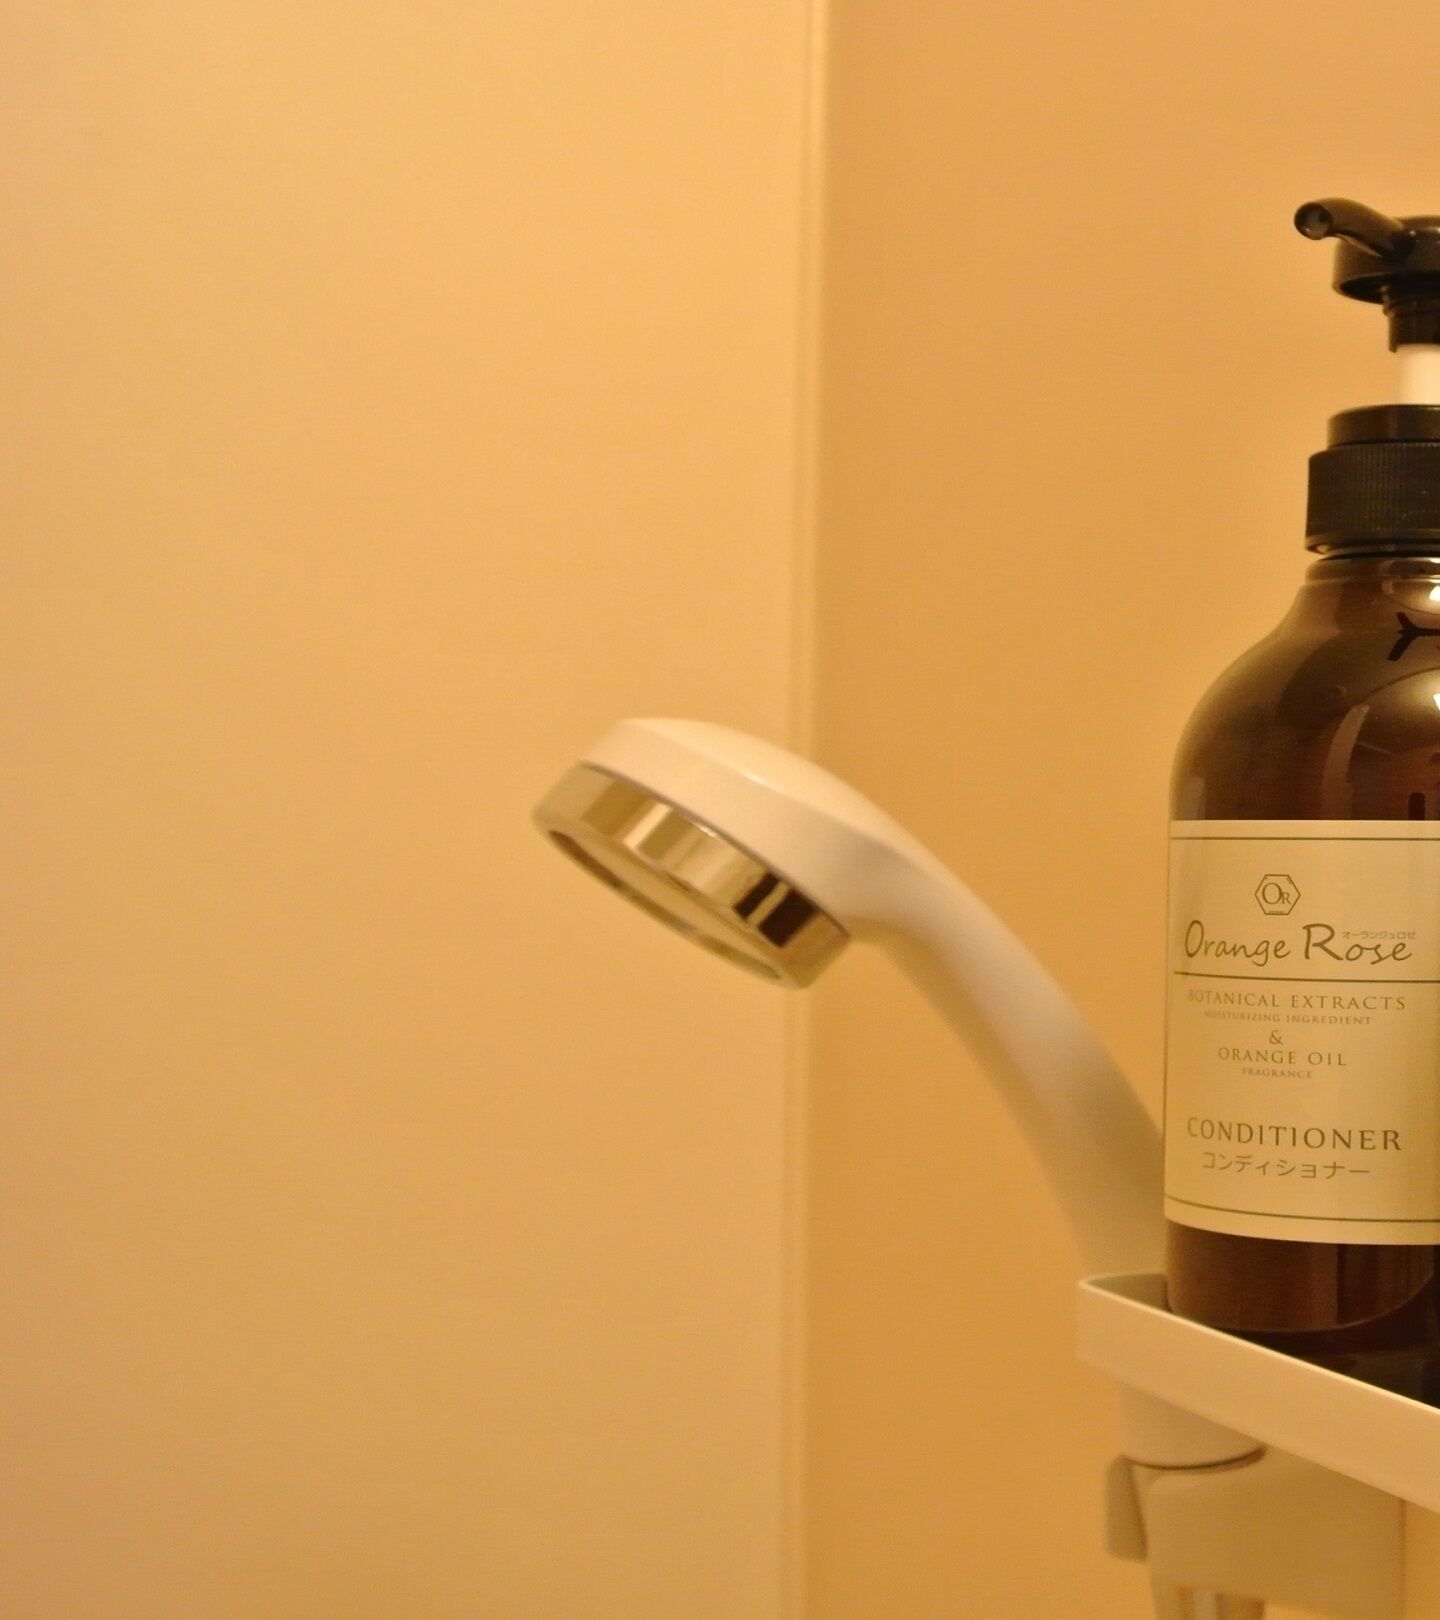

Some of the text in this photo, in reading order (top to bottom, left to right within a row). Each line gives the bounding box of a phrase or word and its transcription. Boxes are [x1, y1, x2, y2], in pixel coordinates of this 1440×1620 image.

[1262, 881, 1291, 906] OR
[1184, 919, 1412, 967] Orange Rose
[1188, 989, 1406, 1011] BOTANICAL EXTRACTS
[1204, 1010, 1373, 1026] MOISTURIZING INGREDIENT
[1268, 1030, 1284, 1045] &
[1218, 1047, 1348, 1067] ORANGE OIL
[1242, 1068, 1313, 1080] FRAGRANCE
[1187, 1117, 1402, 1151] CONDITIONER
[1202, 1152, 1370, 1180] コンディショナー
